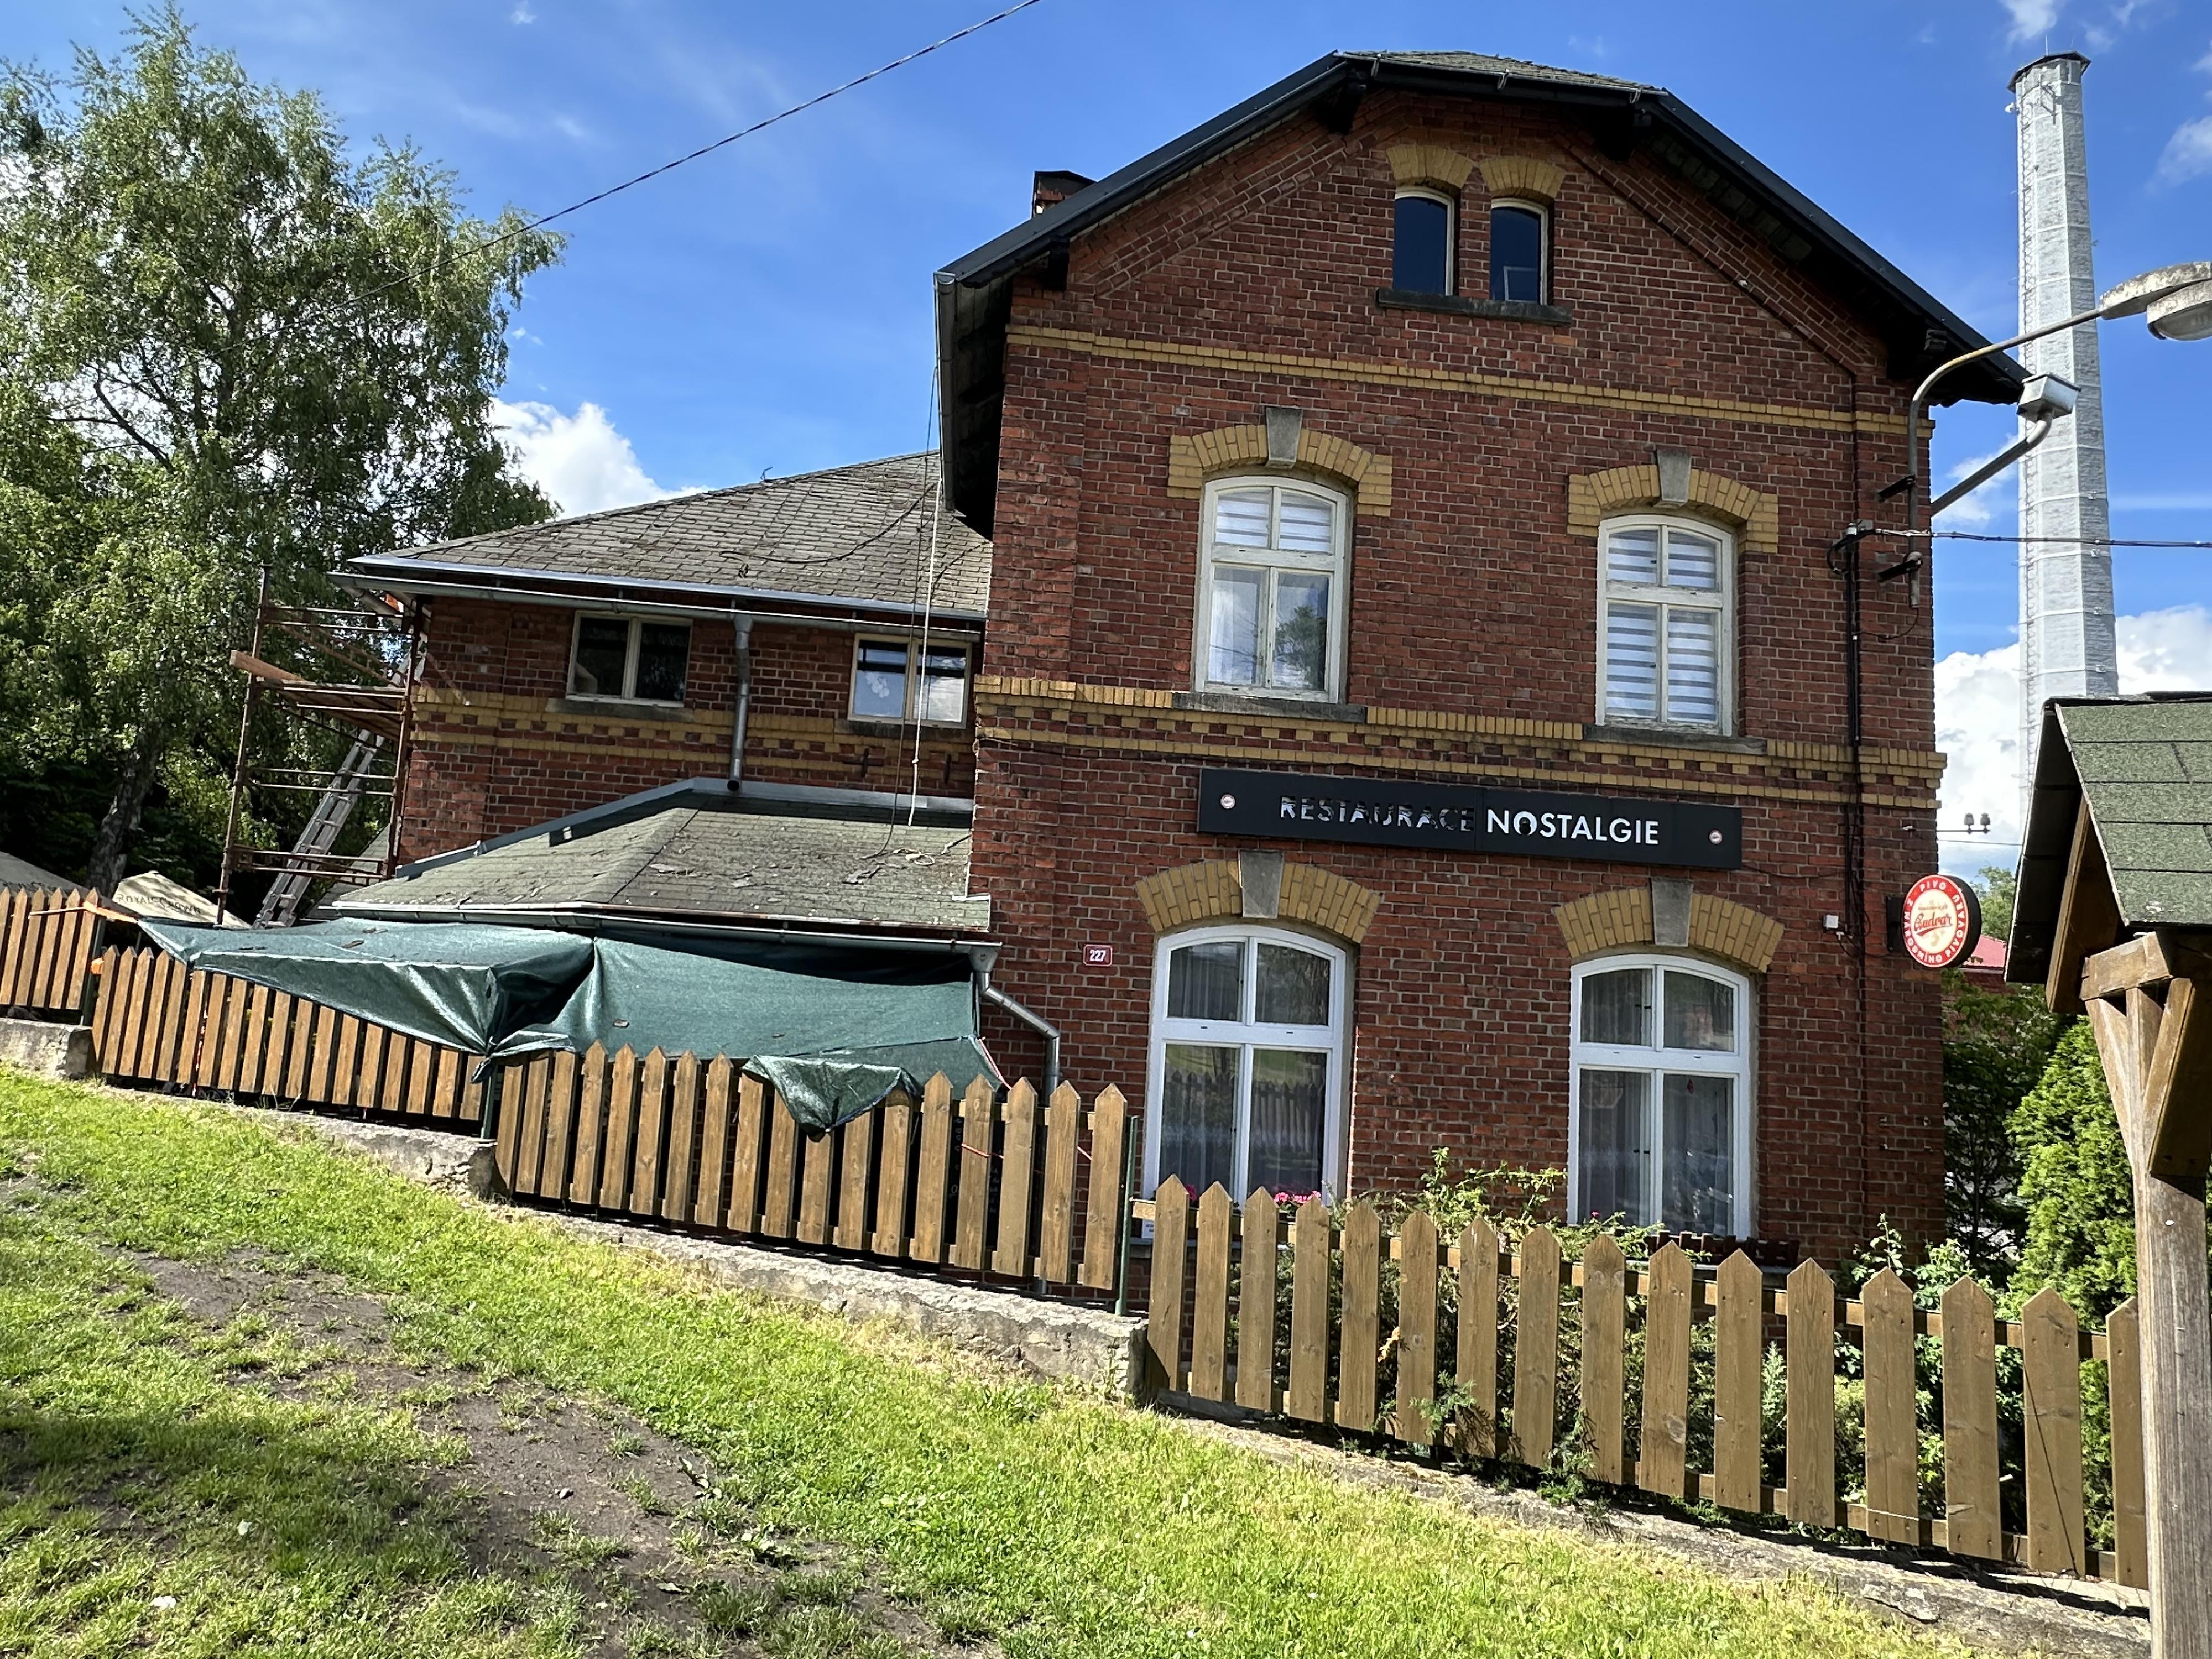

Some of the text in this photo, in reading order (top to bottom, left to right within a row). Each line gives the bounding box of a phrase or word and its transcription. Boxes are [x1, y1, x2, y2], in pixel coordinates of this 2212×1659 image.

[1280, 796, 1659, 844] RESTAURACE NOSTALGIE
[1919, 880, 1947, 891] PIVO
[116, 893, 154, 905] ROYAL
[1914, 912, 1952, 932] Budvar
[1944, 894, 1965, 958] PIVOVARU
[1089, 949, 1107, 962] 227
